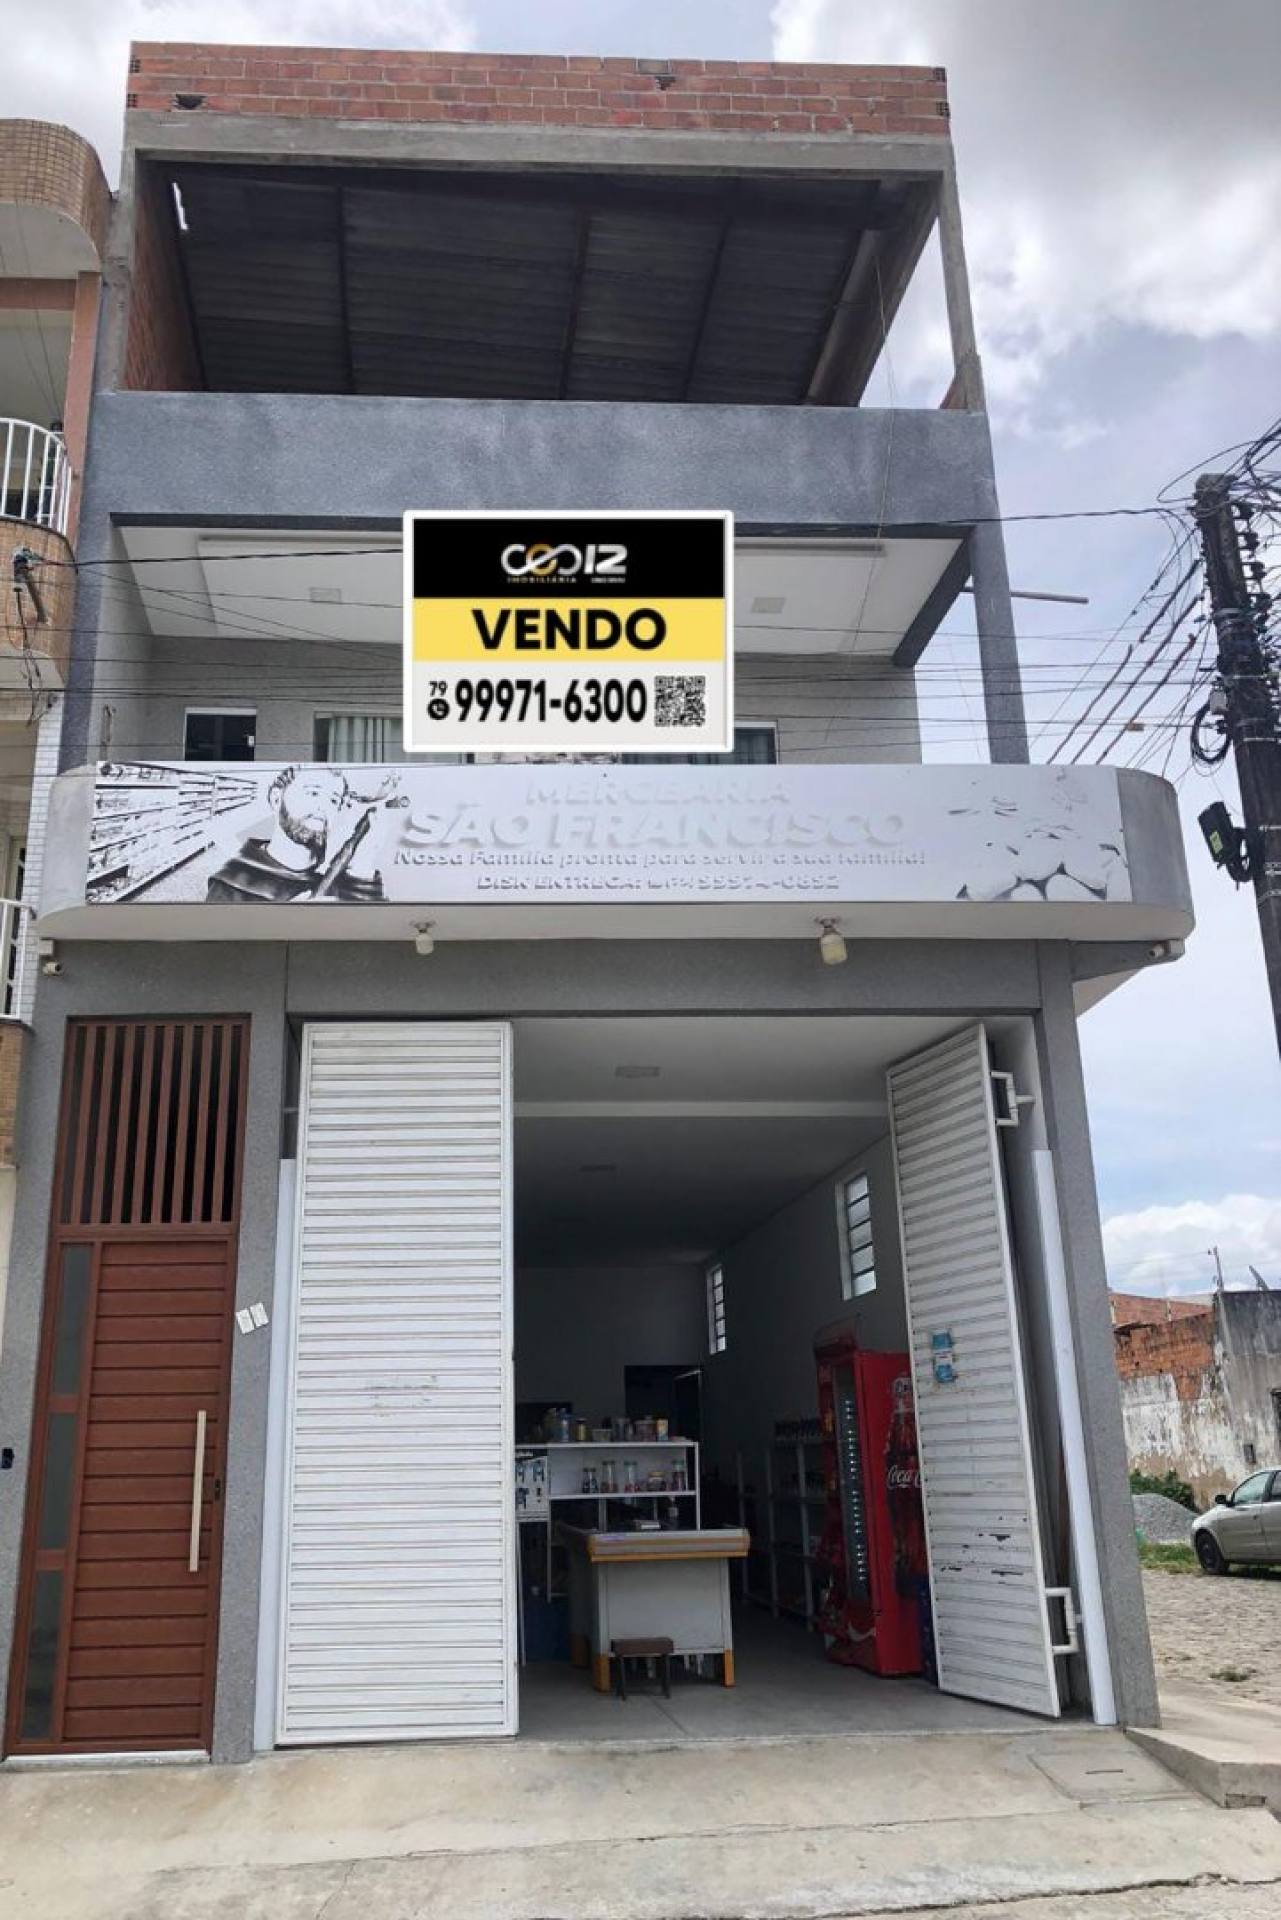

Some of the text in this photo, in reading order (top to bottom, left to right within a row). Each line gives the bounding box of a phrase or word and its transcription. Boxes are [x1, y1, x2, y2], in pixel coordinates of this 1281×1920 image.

[525, 780, 790, 804] MERCEARIA
[397, 801, 906, 848] SÃO FRANCISCO
[393, 850, 464, 865] Nossa
